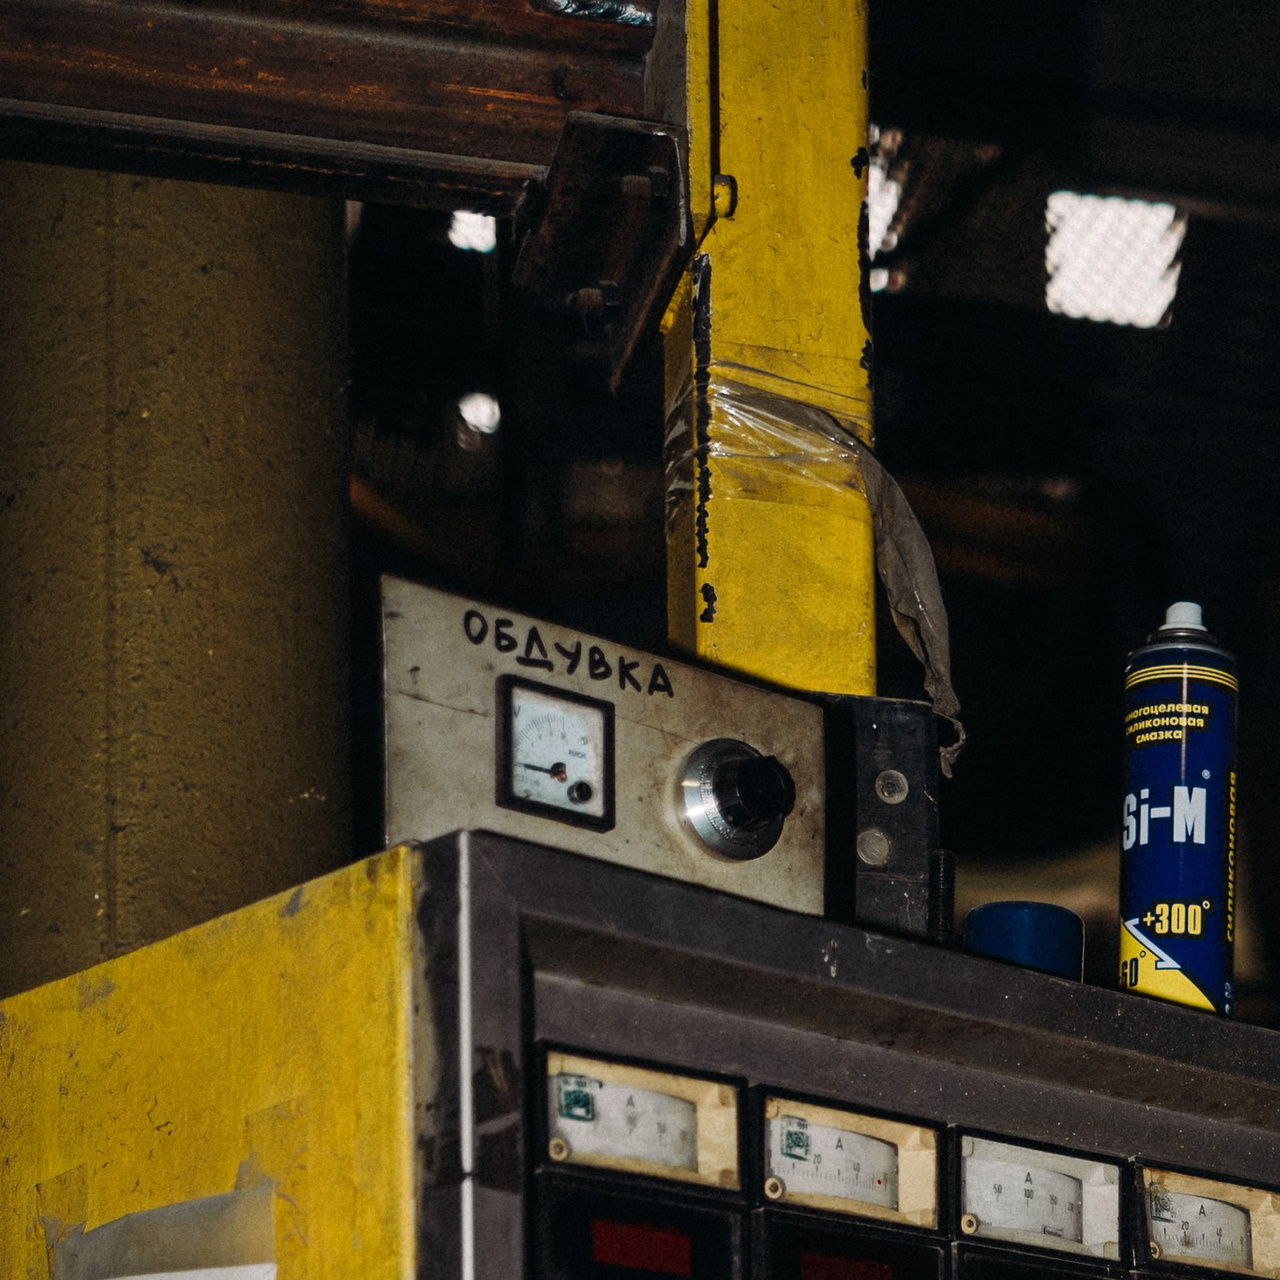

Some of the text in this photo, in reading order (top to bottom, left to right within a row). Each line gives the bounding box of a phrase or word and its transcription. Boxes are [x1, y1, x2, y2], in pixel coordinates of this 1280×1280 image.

[465, 611, 674, 697] ОБДУВКА
[1136, 730, 1183, 745] смазка
[1122, 785, 1207, 852] Si-M
[1143, 900, 1211, 935] +300°
[835, 1137, 844, 1151] A
[812, 1153, 822, 1165] 20
[1024, 1171, 1033, 1185] A
[993, 1184, 1003, 1195] 50
[1023, 1188, 1034, 1200] 100
[1198, 1204, 1207, 1217] A
[1181, 1220, 1190, 1231] 20
